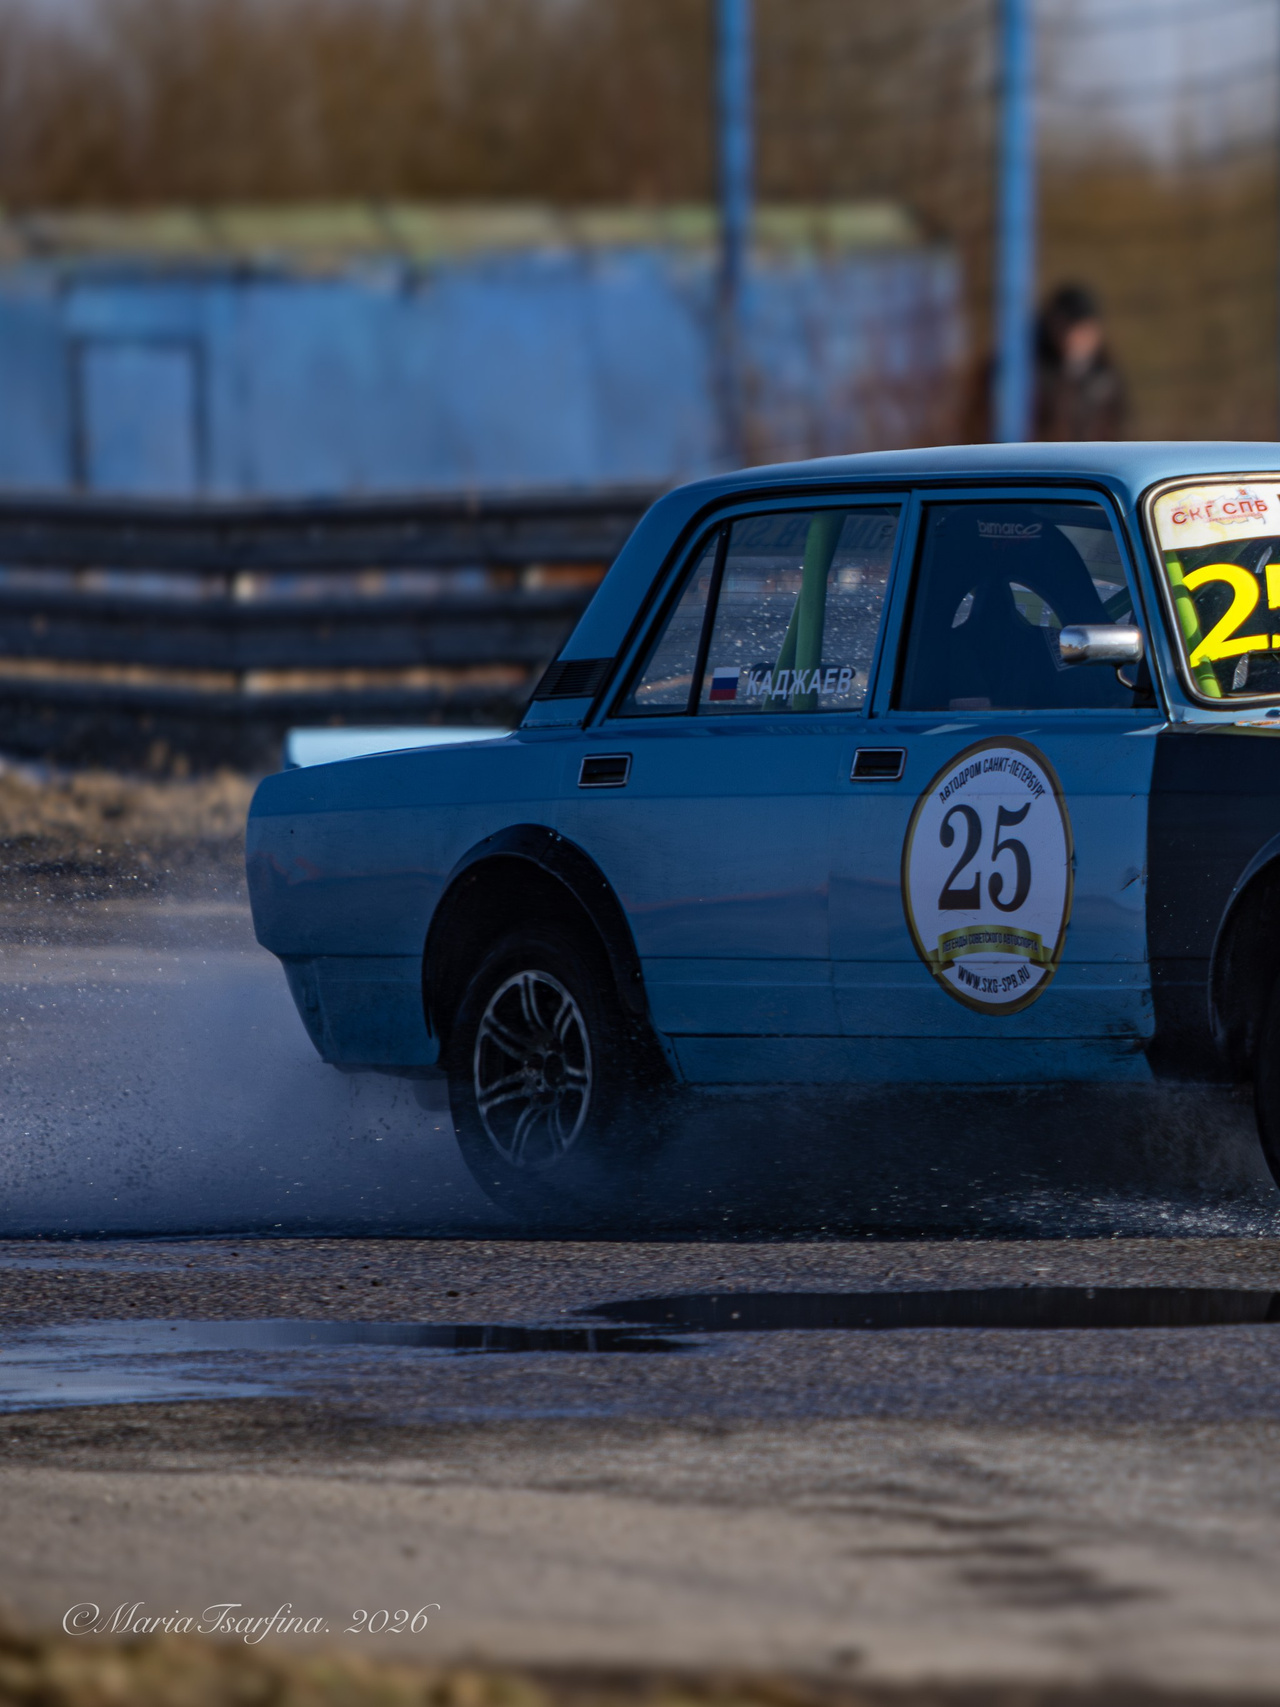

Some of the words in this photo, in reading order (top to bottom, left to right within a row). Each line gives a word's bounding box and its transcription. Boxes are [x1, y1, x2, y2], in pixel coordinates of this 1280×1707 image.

[1222, 499, 1269, 515] СПБ
[745, 667, 853, 701] КАДЖАЕВ
[938, 760, 982, 804] АВТОДРОМ
[983, 756, 1046, 800] САНКТ-ПЕТЕРБУРГ
[938, 802, 1031, 912] 25
[957, 964, 1031, 994] WWW.SKG-SPB.RU
